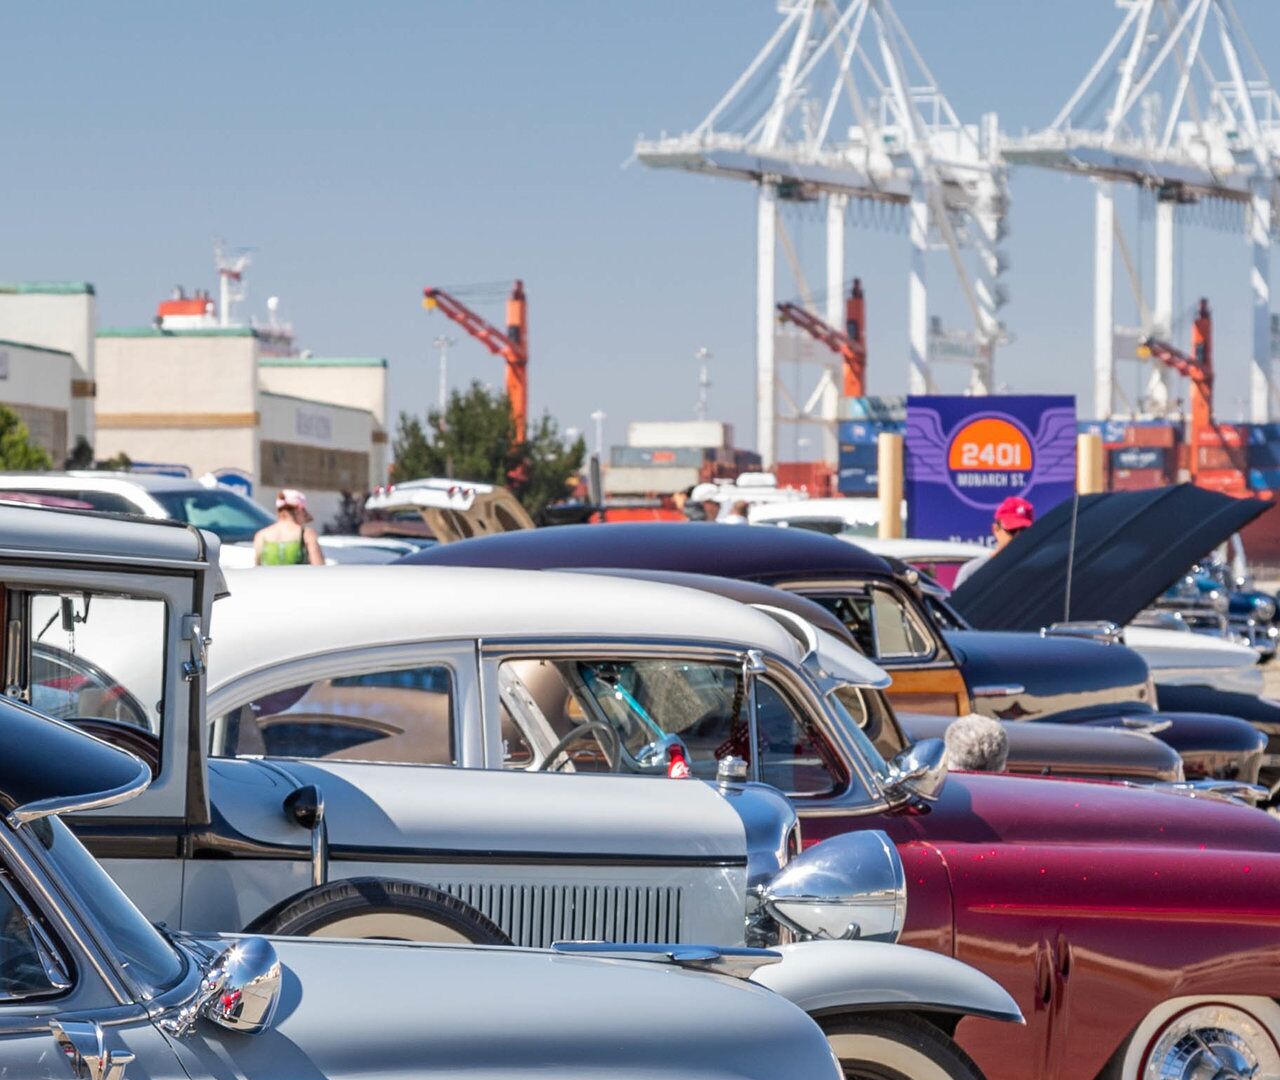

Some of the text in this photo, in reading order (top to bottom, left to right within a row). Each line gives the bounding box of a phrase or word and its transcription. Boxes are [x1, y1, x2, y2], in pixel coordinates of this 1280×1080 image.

[961, 442, 1021, 466] 2401
[957, 472, 1026, 487] MONARCH ST.
